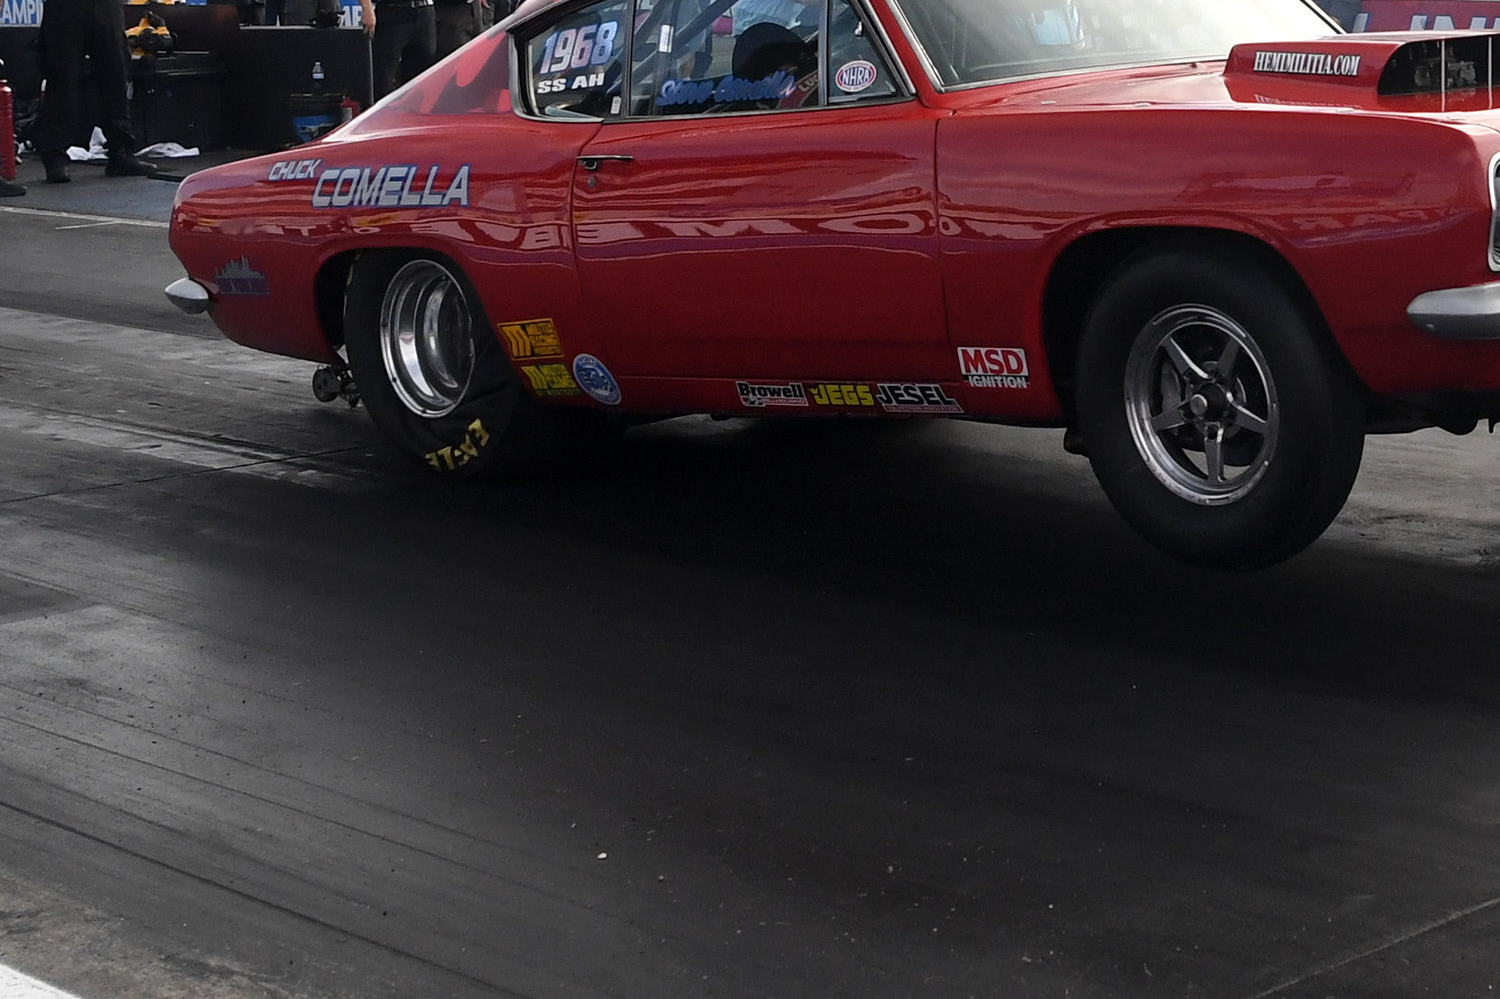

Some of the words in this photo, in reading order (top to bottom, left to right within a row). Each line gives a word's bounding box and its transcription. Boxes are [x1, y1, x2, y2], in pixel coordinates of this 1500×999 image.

[540, 21, 618, 75] 1968
[1253, 51, 1361, 77] HEMIMILITIA.COM
[537, 75, 568, 94] SS
[572, 73, 605, 91] AH
[842, 66, 870, 86] NHRA
[268, 159, 321, 182] CHUCK
[311, 163, 471, 208] COMELLA
[961, 348, 1024, 375] MSD
[737, 382, 805, 398] Browell
[968, 376, 1028, 389] IGNITION
[814, 384, 875, 406] JEGS
[878, 385, 958, 406] JESEL
